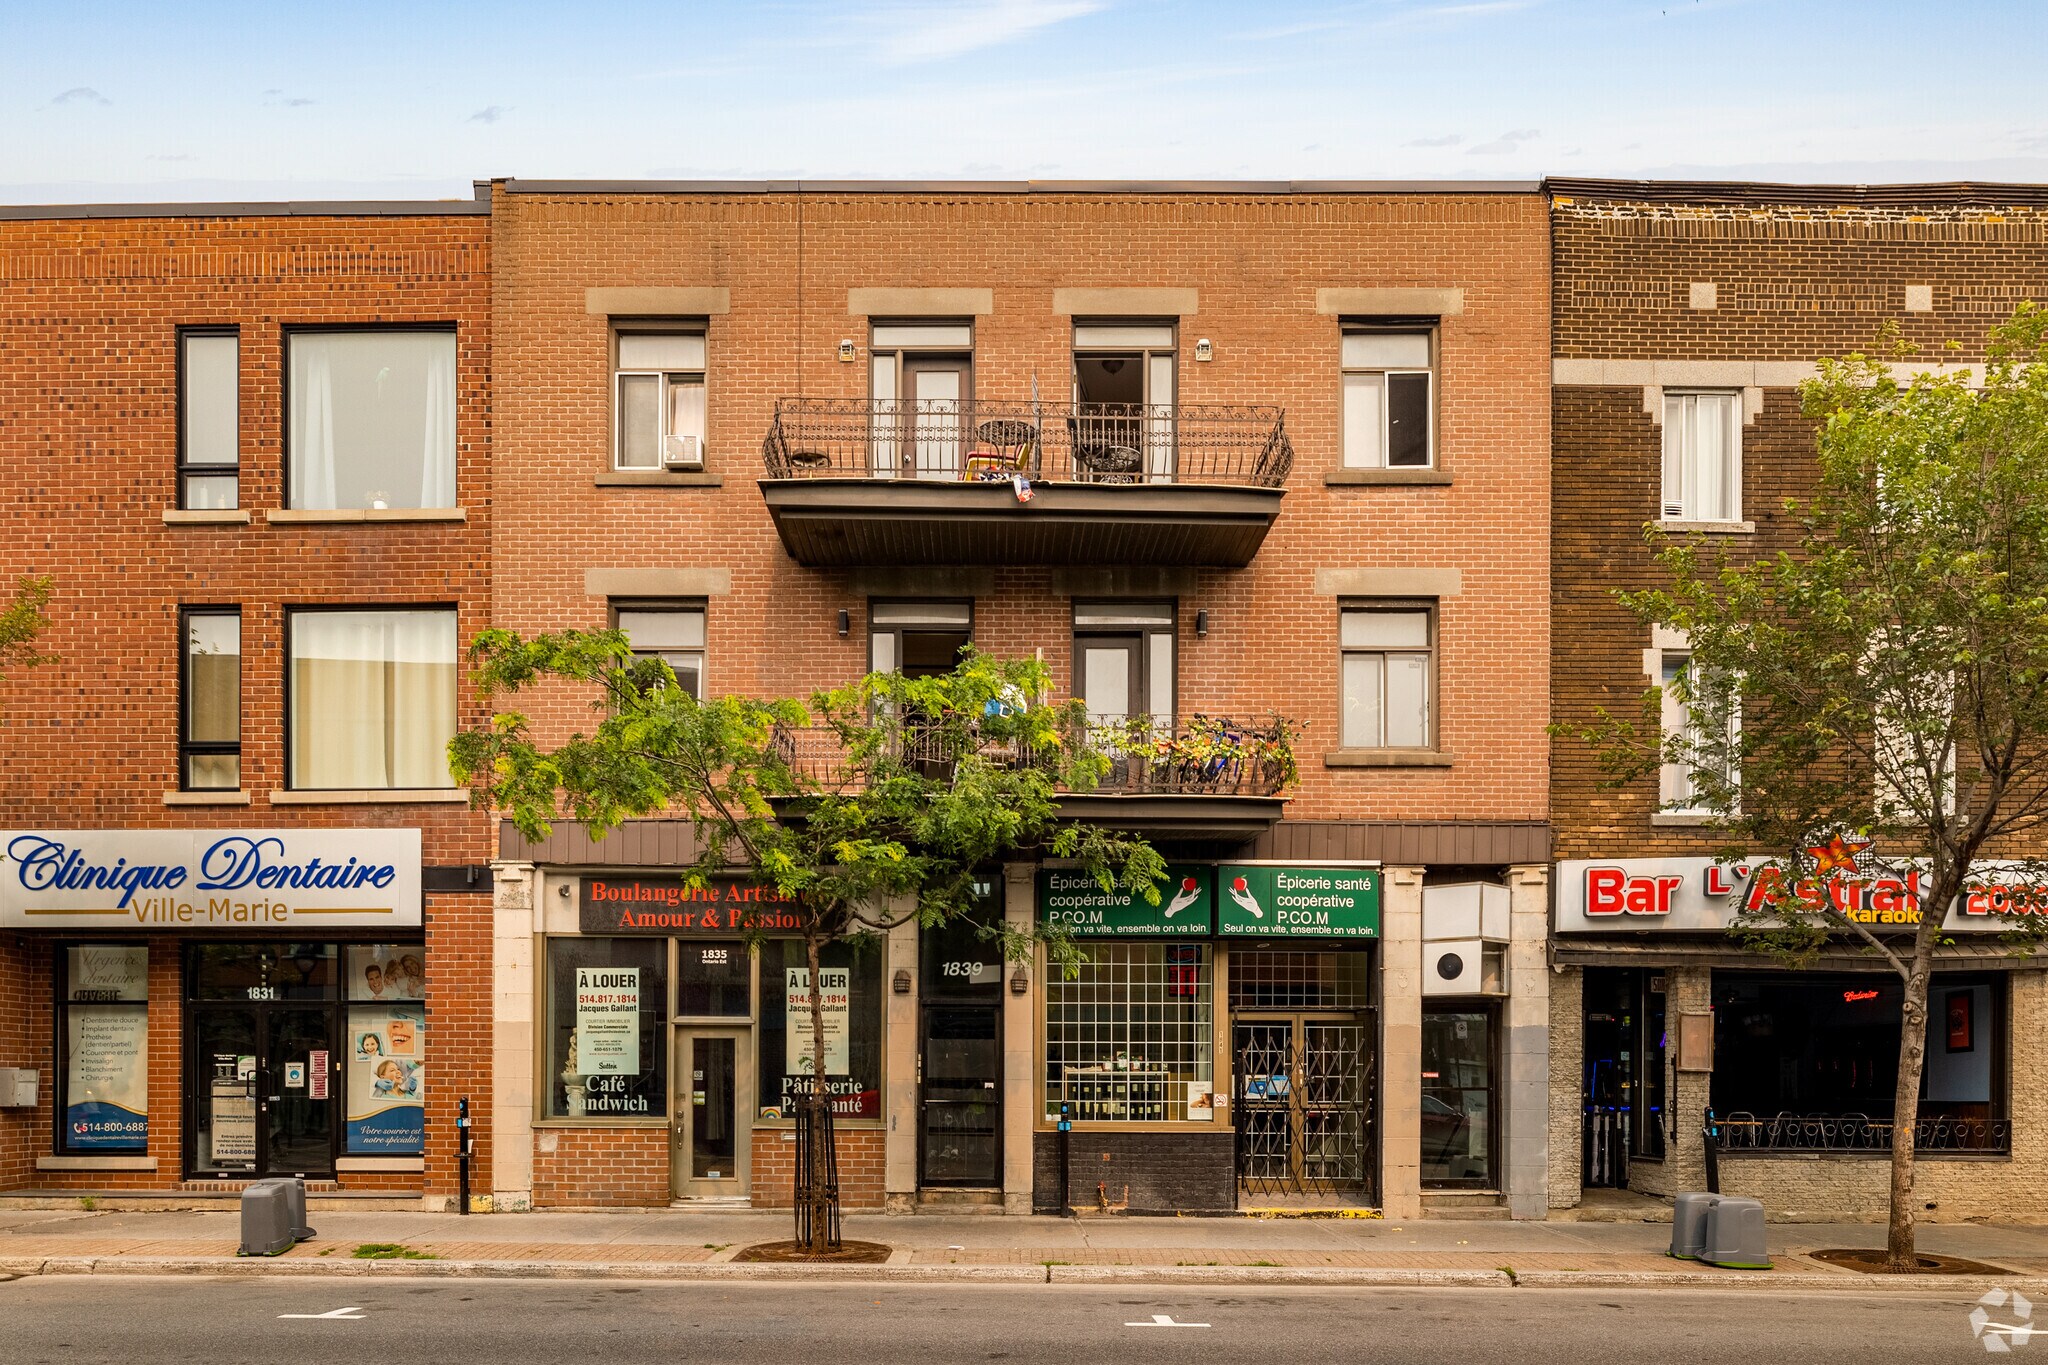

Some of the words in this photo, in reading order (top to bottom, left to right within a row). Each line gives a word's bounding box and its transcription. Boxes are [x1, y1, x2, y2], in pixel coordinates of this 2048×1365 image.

[7, 835, 188, 908] Clinique
[196, 837, 396, 890] Dentaire
[1277, 873, 1331, 891] Épicerie
[1335, 878, 1371, 891] santé
[1585, 866, 1684, 916] Bar
[1049, 894, 1131, 909] coopérative
[1277, 894, 1354, 909] coopérative
[132, 898, 288, 922] Ville-Marie
[1846, 905, 1924, 924] karaok
[619, 908, 695, 928] Amour
[701, 908, 721, 928] &
[1096, 925, 1115, 934] vite,
[1117, 924, 1161, 933] ensemble
[1190, 924, 1206, 932] loin
[1224, 923, 1243, 933] Seul
[1271, 925, 1288, 934] vite,
[1291, 925, 1331, 934] ensemble
[1358, 927, 1373, 935] loin
[701, 950, 727, 959] 1835
[942, 962, 983, 976] 1839
[579, 971, 589, 988] À
[593, 975, 636, 988] LOUER
[789, 971, 798, 988] À
[803, 975, 846, 988] LUER
[247, 987, 274, 999] 1831
[579, 995, 637, 1003] 514.817.1814
[789, 995, 846, 1003] 514.87.1814
[579, 1005, 609, 1013] Jacques
[611, 1004, 637, 1012] Gallant
[789, 1005, 811, 1013] Jacqu
[821, 1004, 847, 1012] Gallant
[585, 1075, 625, 1092] Café
[781, 1077, 863, 1094] Pâtiserie
[831, 1096, 863, 1113] anté
[360, 1125, 382, 1134] Votre
[385, 1135, 420, 1147] spécialité
